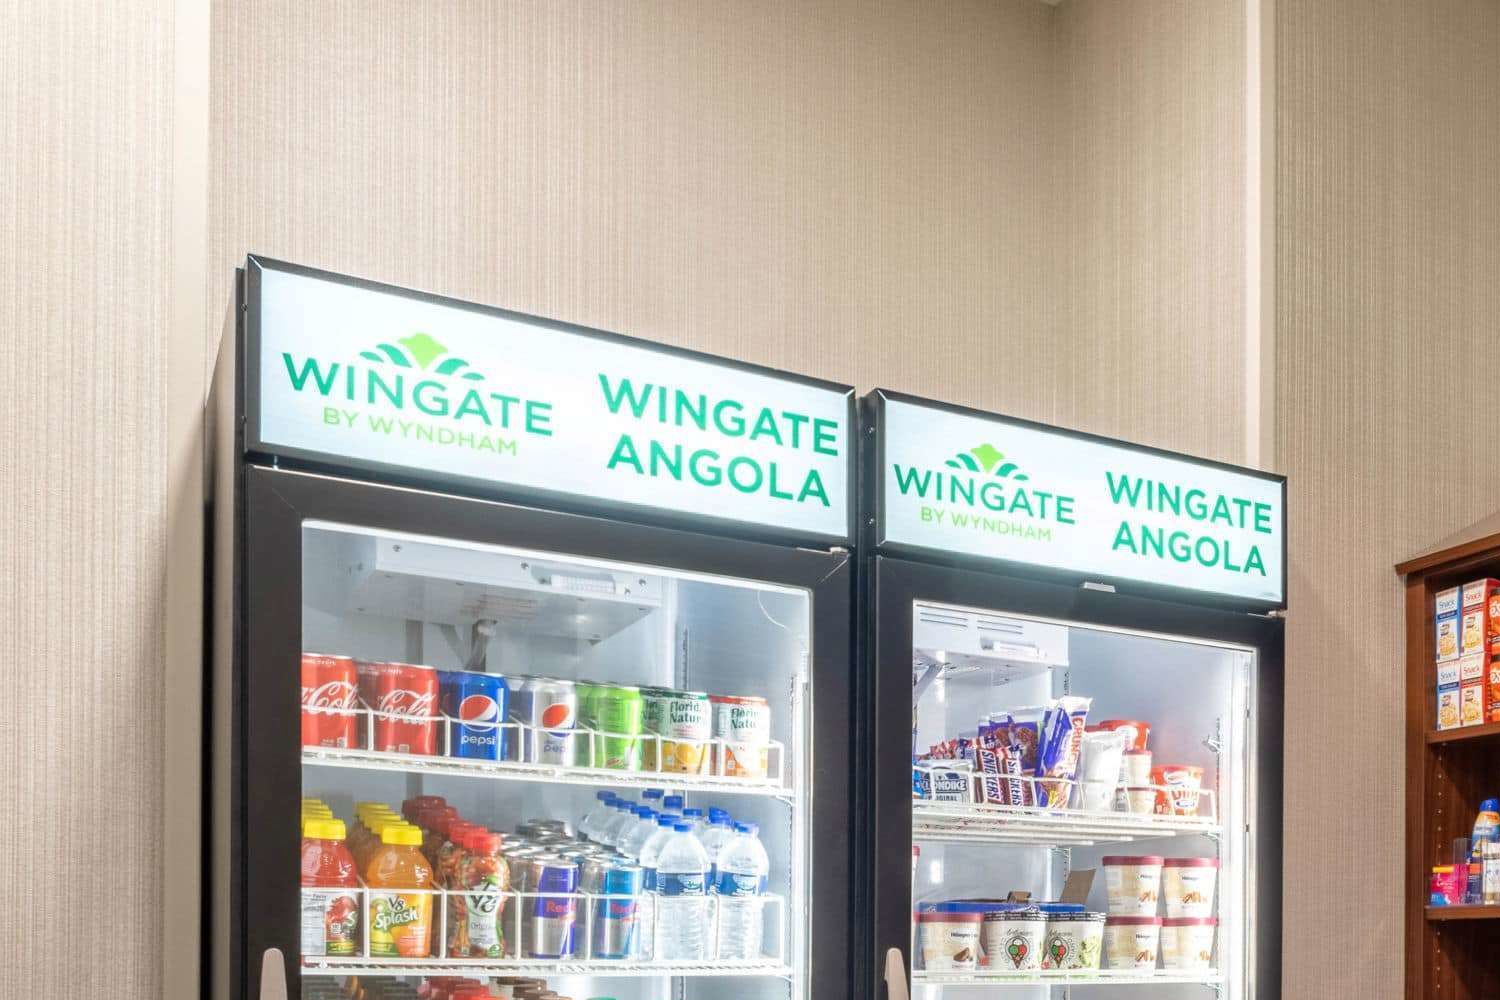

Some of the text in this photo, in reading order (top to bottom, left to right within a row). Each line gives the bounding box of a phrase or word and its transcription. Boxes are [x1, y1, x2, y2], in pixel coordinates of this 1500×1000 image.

[283, 352, 554, 437] WINGATE
[600, 373, 840, 457] WINGATE
[323, 407, 519, 457] BY WYNDHAM
[607, 434, 832, 507] ANGOLA
[893, 463, 1076, 525] WINGATE
[920, 505, 1052, 542] BY WYNDHAM
[1106, 471, 1273, 535] WINGATE
[1112, 520, 1267, 577] ANGOLA
[375, 907, 418, 931] Splash
